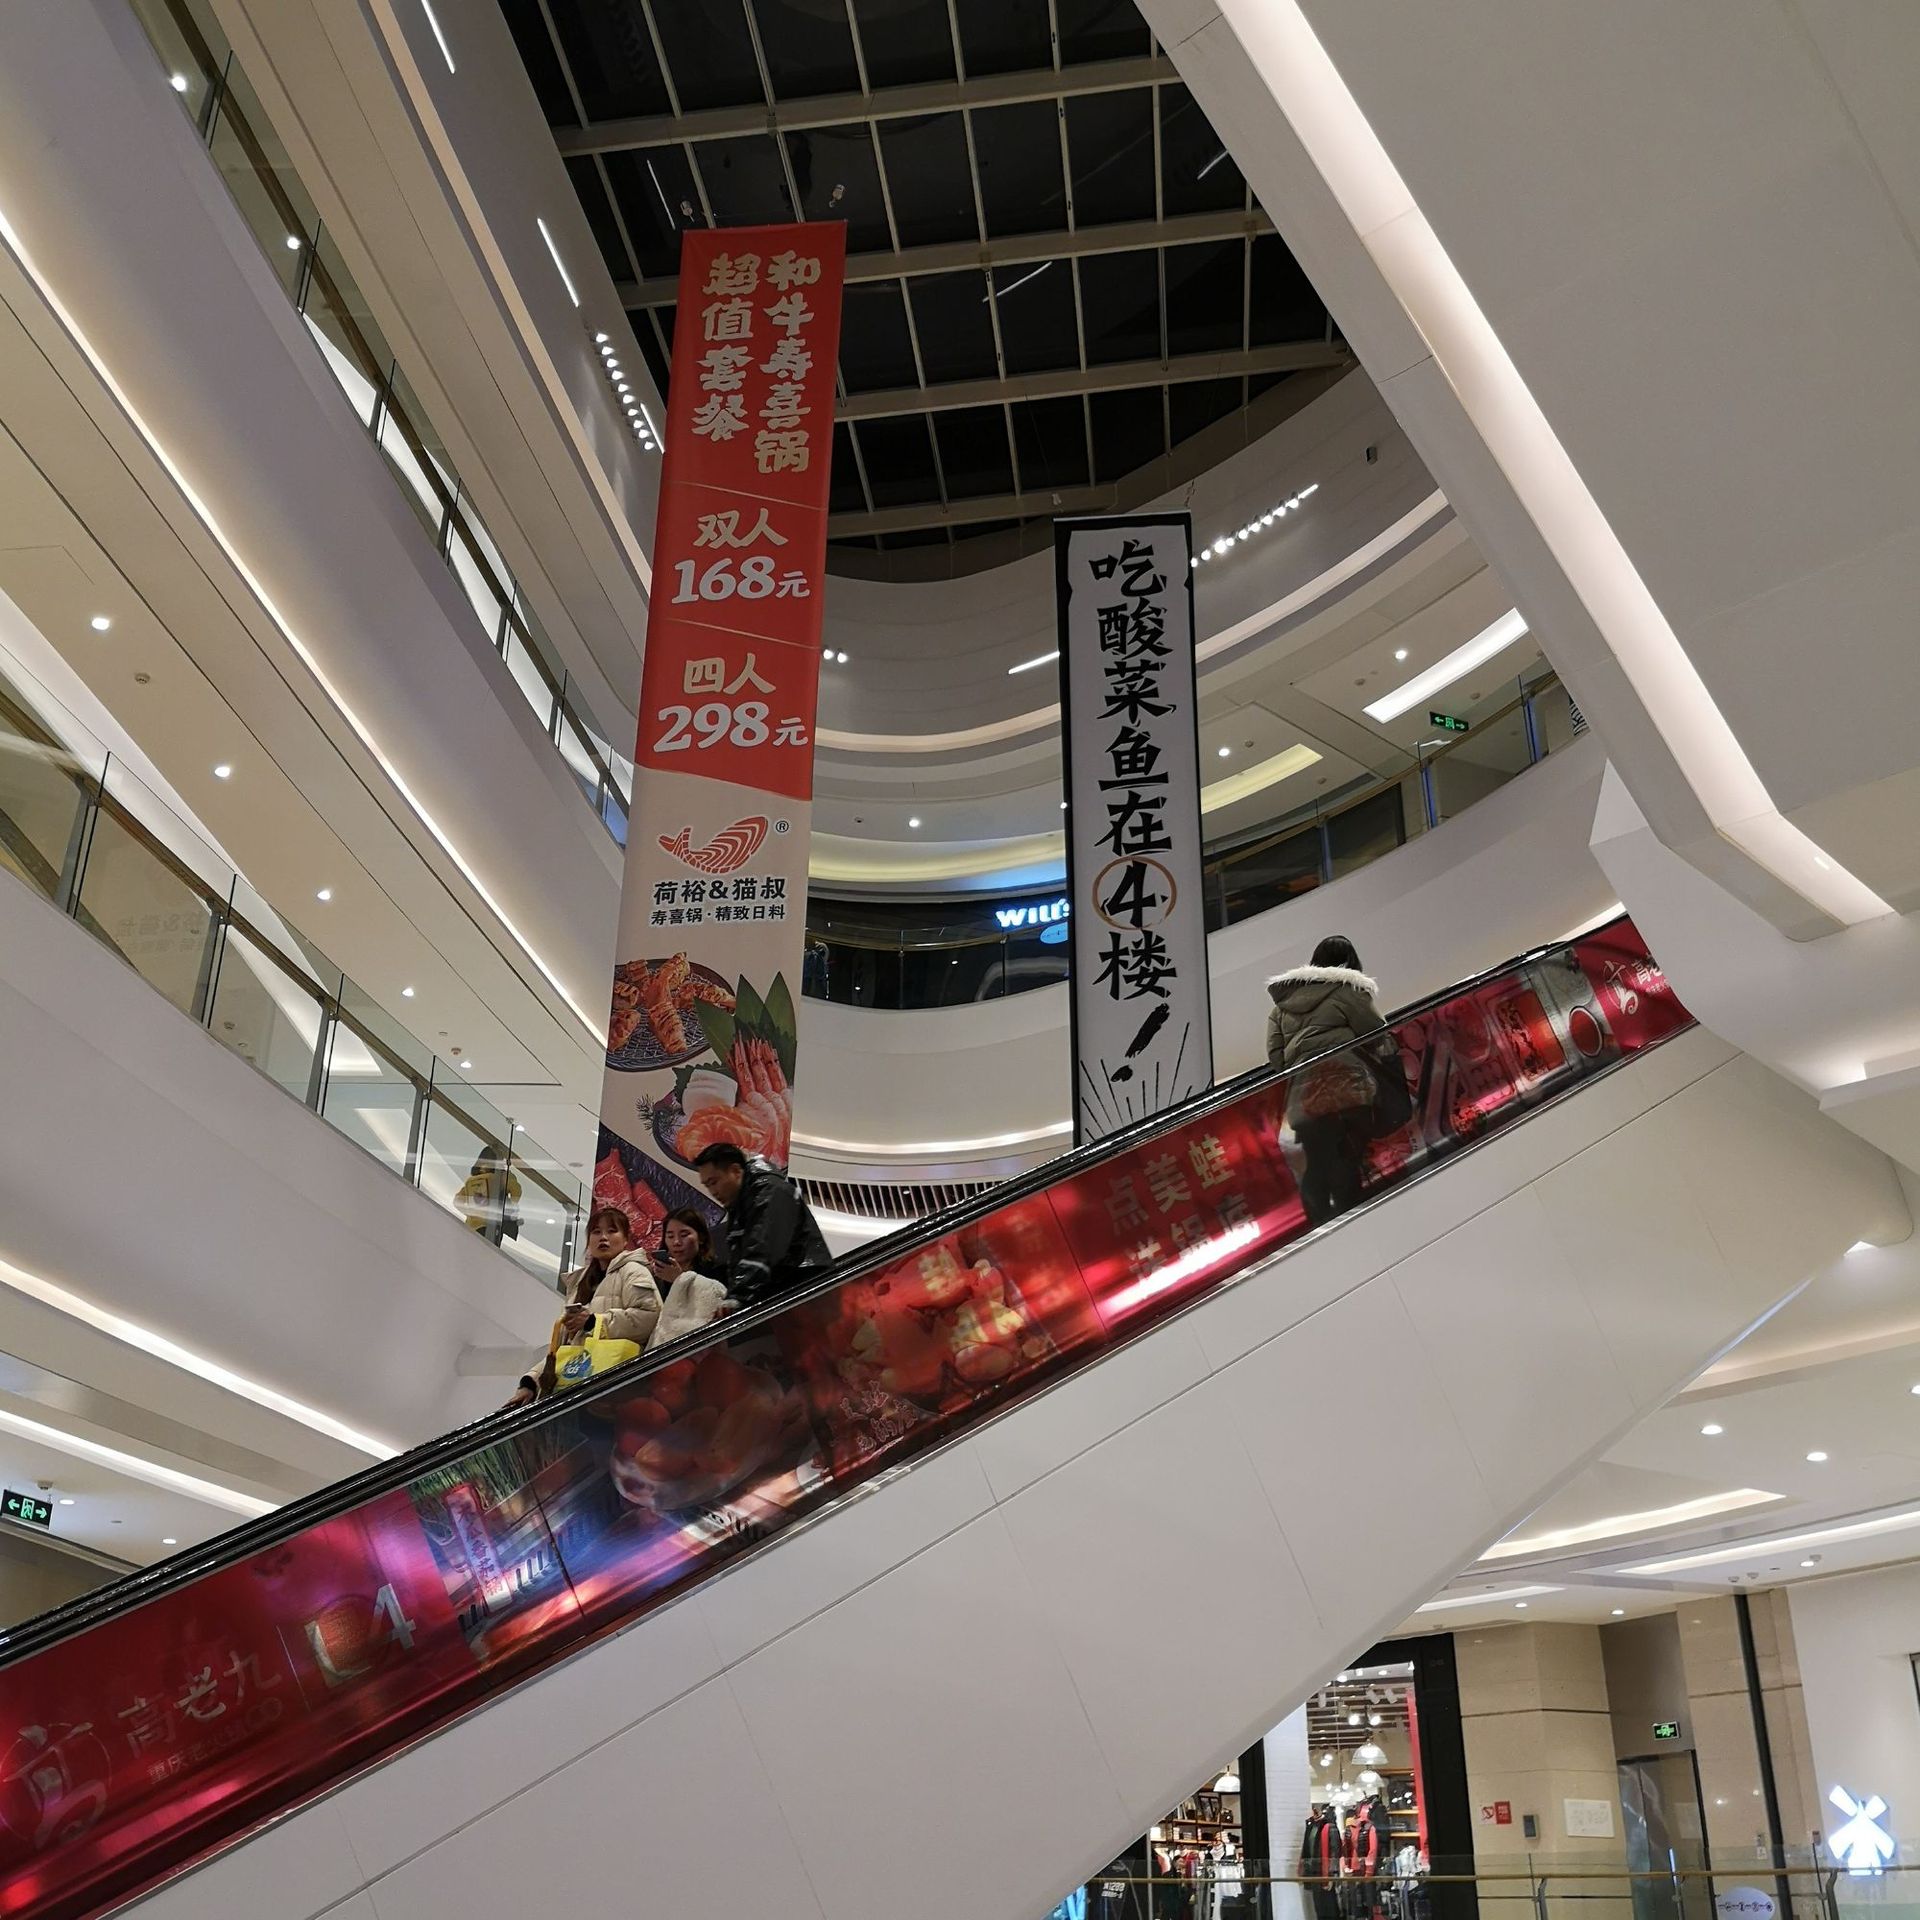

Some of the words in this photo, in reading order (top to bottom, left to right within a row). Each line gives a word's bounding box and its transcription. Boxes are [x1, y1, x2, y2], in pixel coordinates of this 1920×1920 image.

[691, 253, 762, 442] 超值套餐
[754, 250, 821, 474] 和牛寿喜锅
[692, 507, 789, 549] 双人
[671, 556, 811, 604] 168元
[683, 652, 777, 695] 四人
[653, 701, 809, 752] 298元
[653, 877, 786, 905] 荷裕&猫叔
[1103, 1133, 1235, 1236] 点美蛙
[118, 1650, 282, 1760] 高老九
